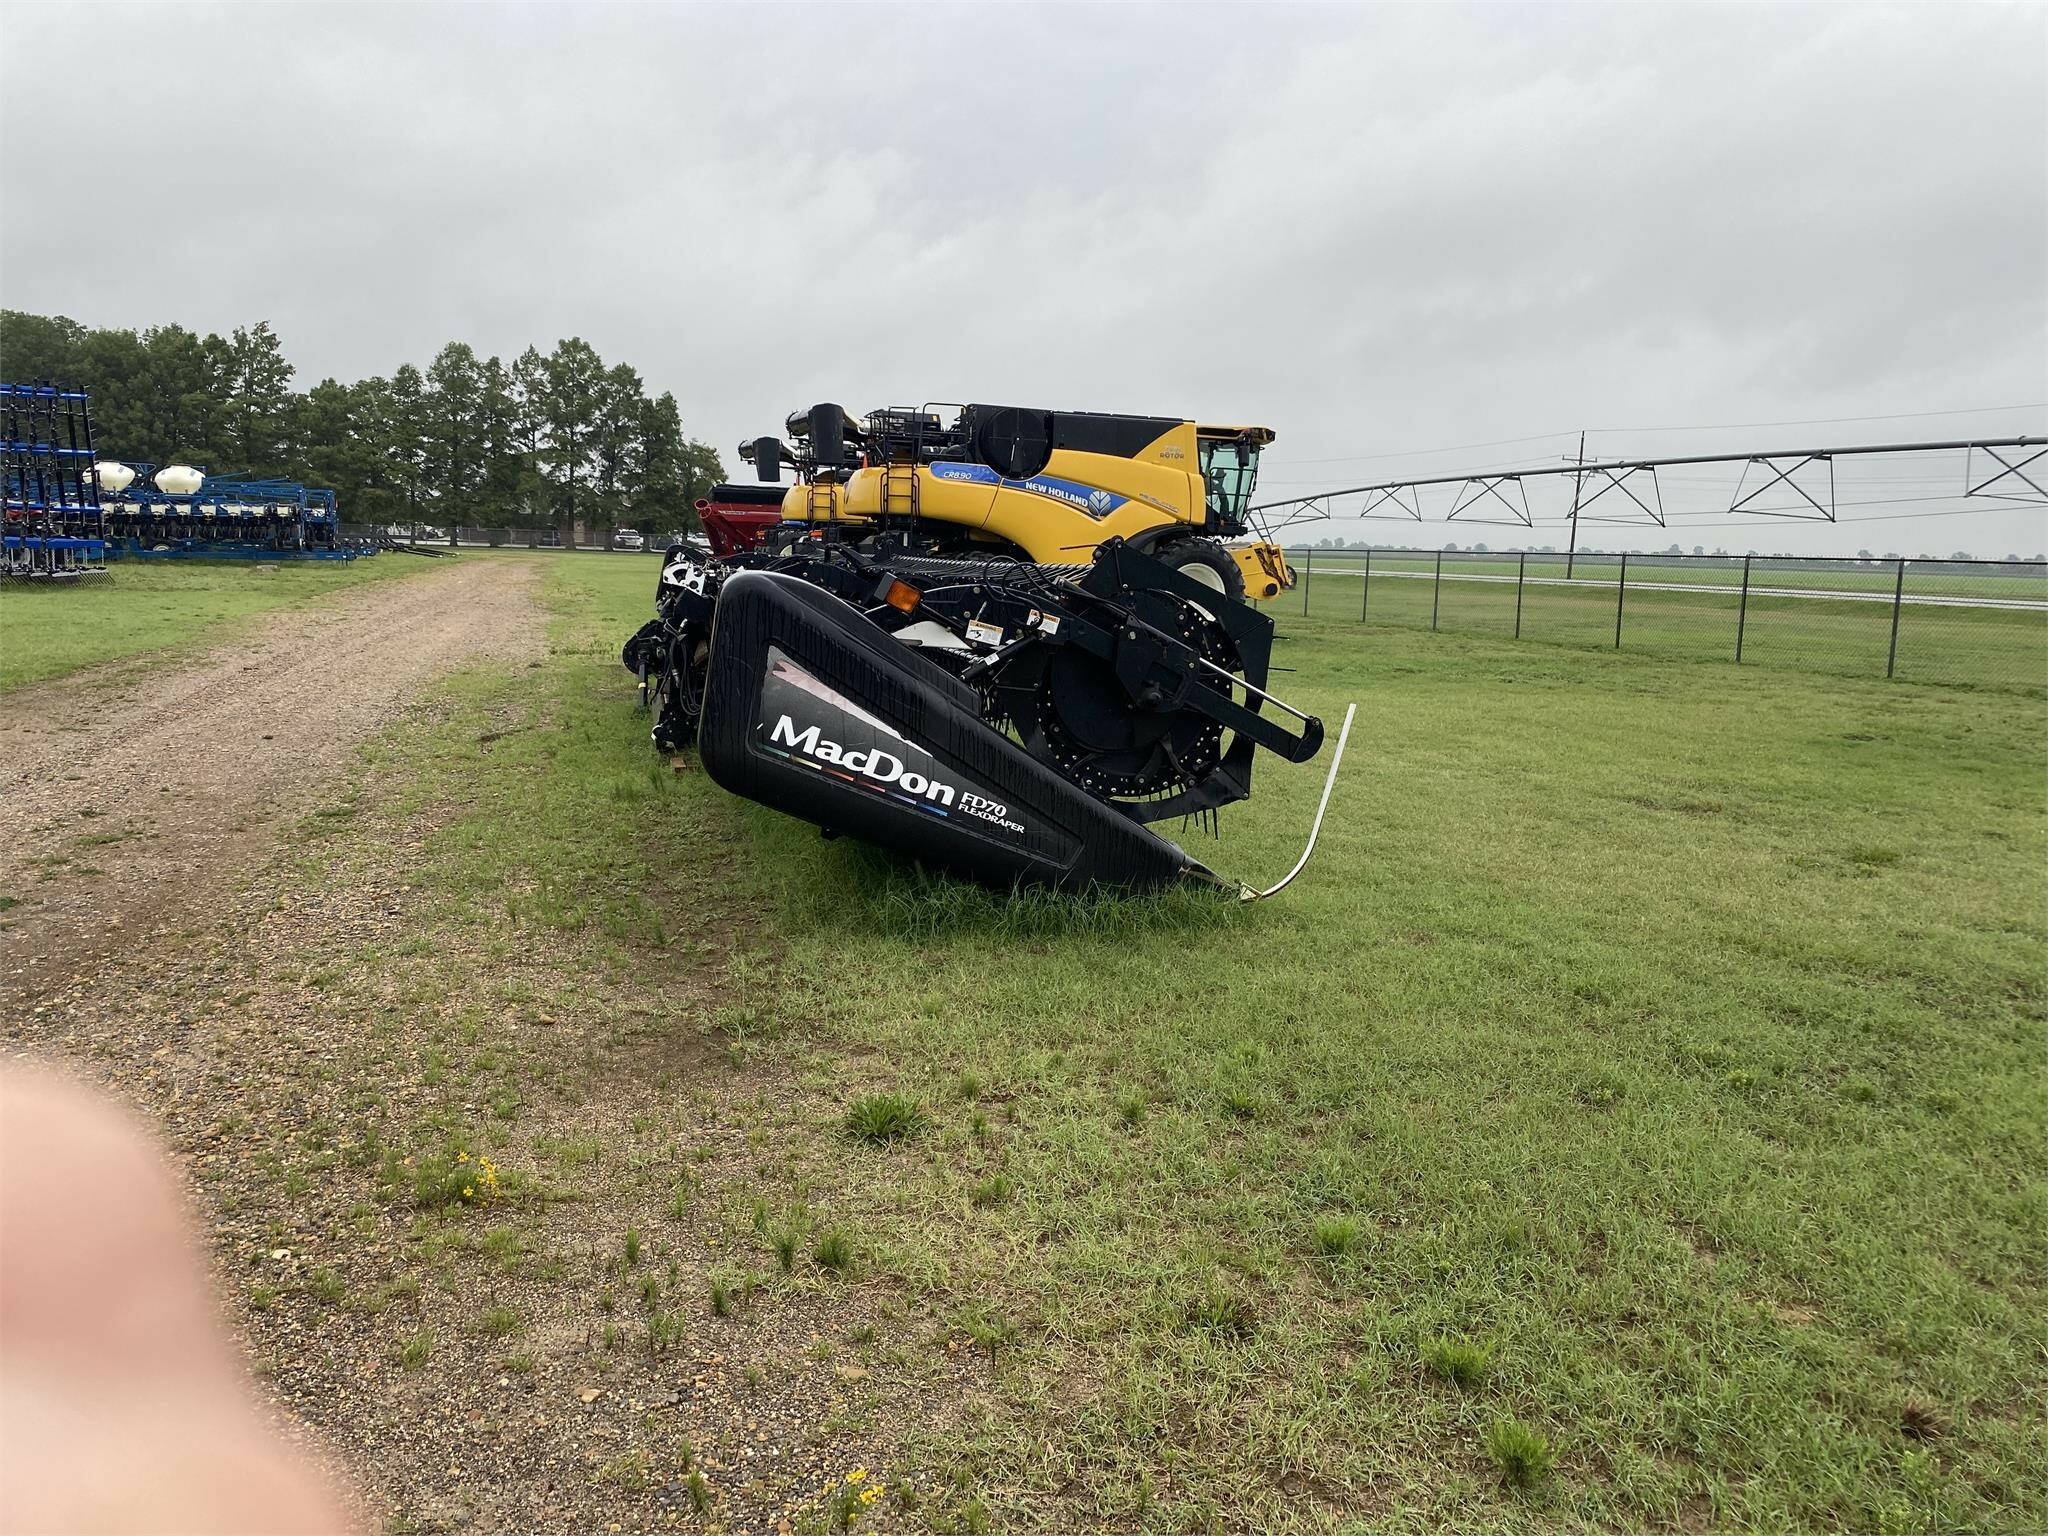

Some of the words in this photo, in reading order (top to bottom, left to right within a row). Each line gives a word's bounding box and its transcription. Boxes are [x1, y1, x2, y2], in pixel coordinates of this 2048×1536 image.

[943, 471, 972, 480] CR8.90
[1025, 481, 1048, 494] NEW
[1048, 486, 1089, 507] HOLLAND
[770, 714, 956, 806] MacDon
[960, 791, 1007, 817] FD70
[958, 803, 1025, 834] FLEXDRAPER
